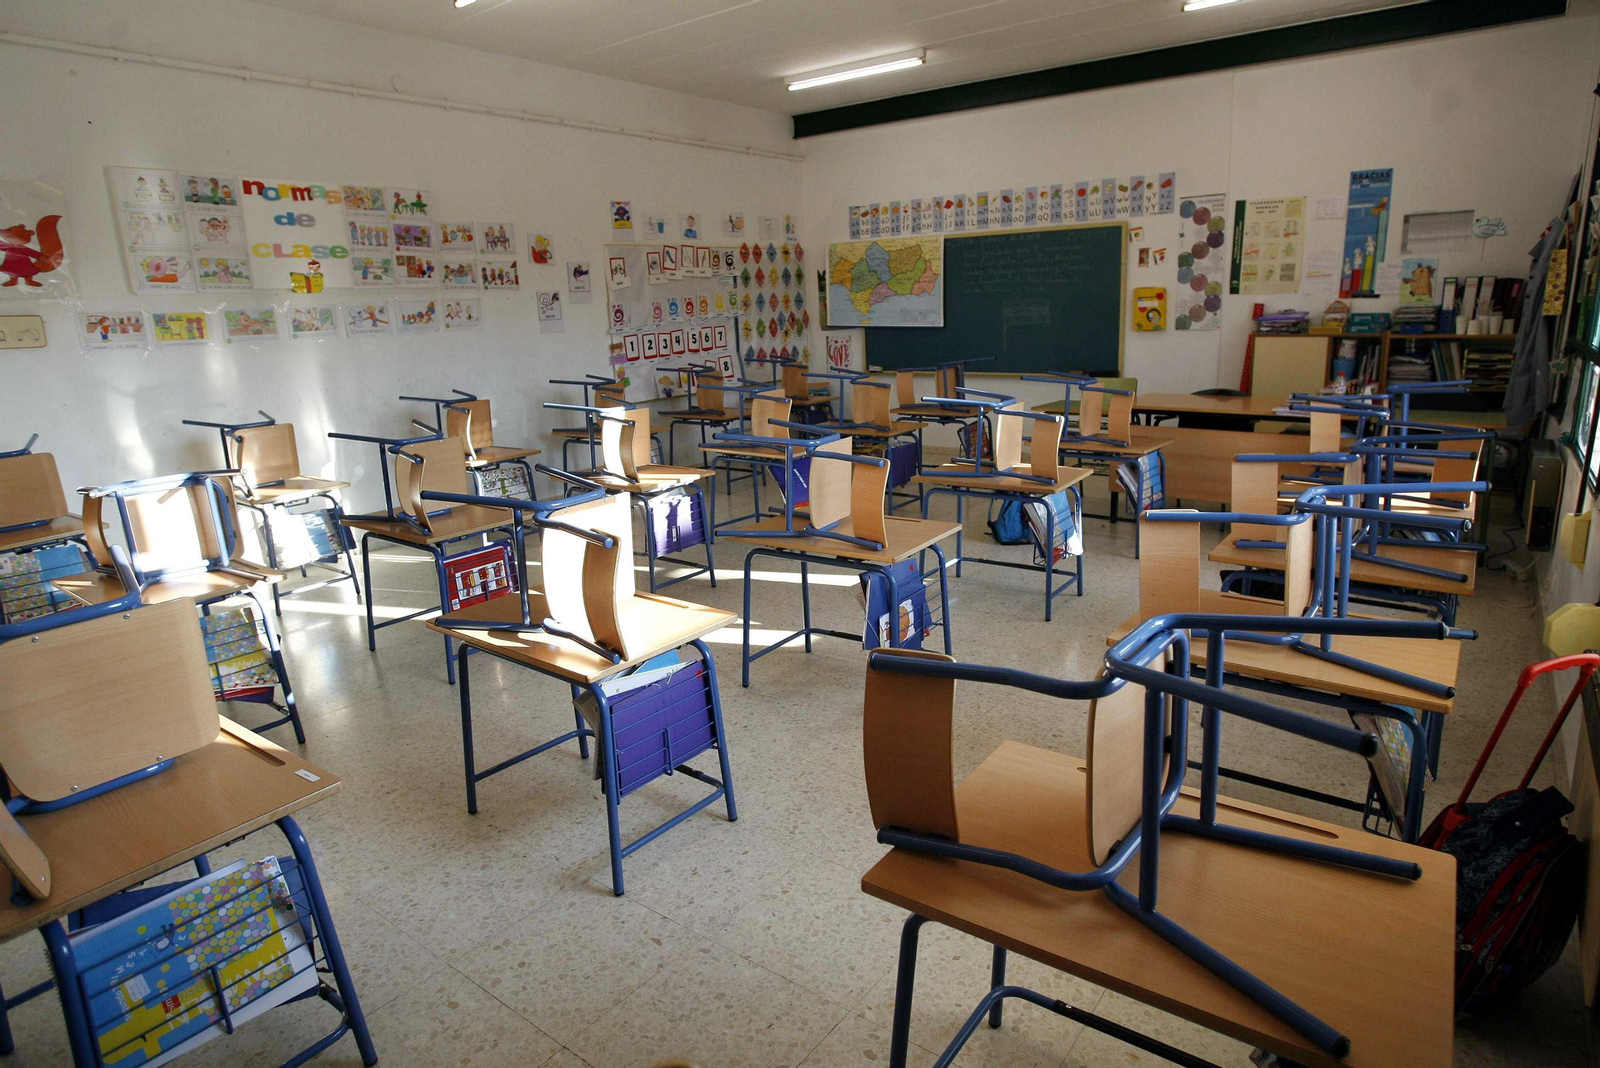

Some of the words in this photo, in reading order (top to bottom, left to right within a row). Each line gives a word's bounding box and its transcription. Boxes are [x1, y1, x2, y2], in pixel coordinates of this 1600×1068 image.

[1352, 171, 1391, 180] GRACIAS
[242, 180, 342, 204] normas
[274, 212, 316, 227] de
[630, 341, 634, 352] 1
[647, 339, 653, 350] 2
[663, 338, 668, 349] 3
[675, 335, 681, 346] 4
[691, 334, 697, 344] 5
[704, 333, 710, 343] 6
[718, 331, 723, 341] 7
[723, 361, 729, 371] 8
